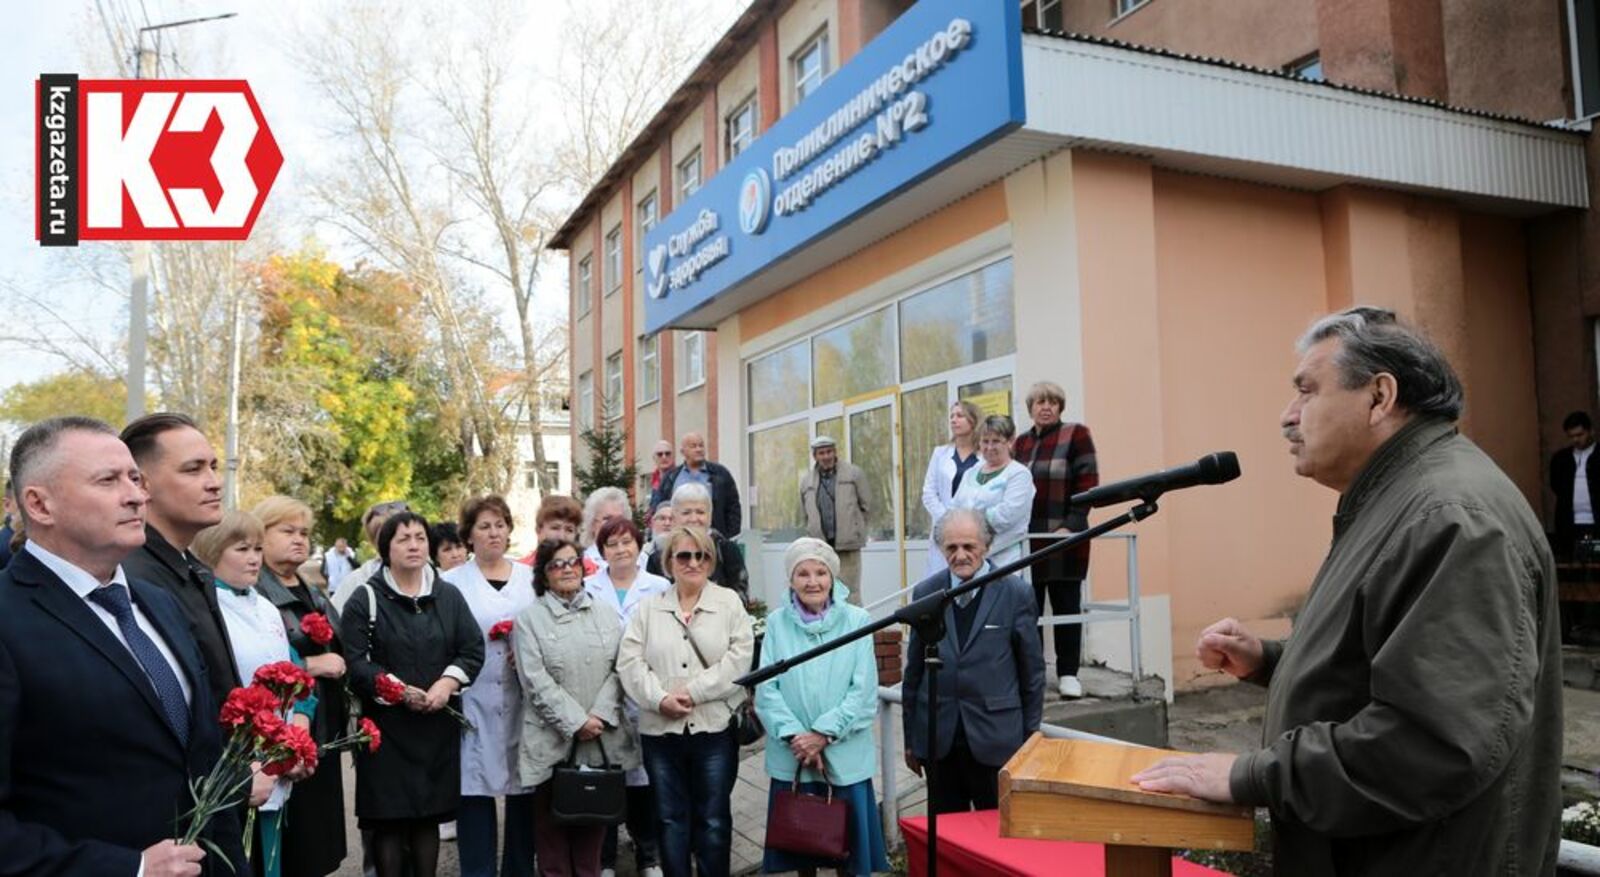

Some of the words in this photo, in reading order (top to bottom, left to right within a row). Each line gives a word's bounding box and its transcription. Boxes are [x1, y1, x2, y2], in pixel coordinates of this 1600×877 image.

[773, 18, 972, 180] Поликлиническое
[773, 132, 876, 217] отделение
[668, 208, 718, 257] Служба
[668, 236, 729, 289] здоровья
